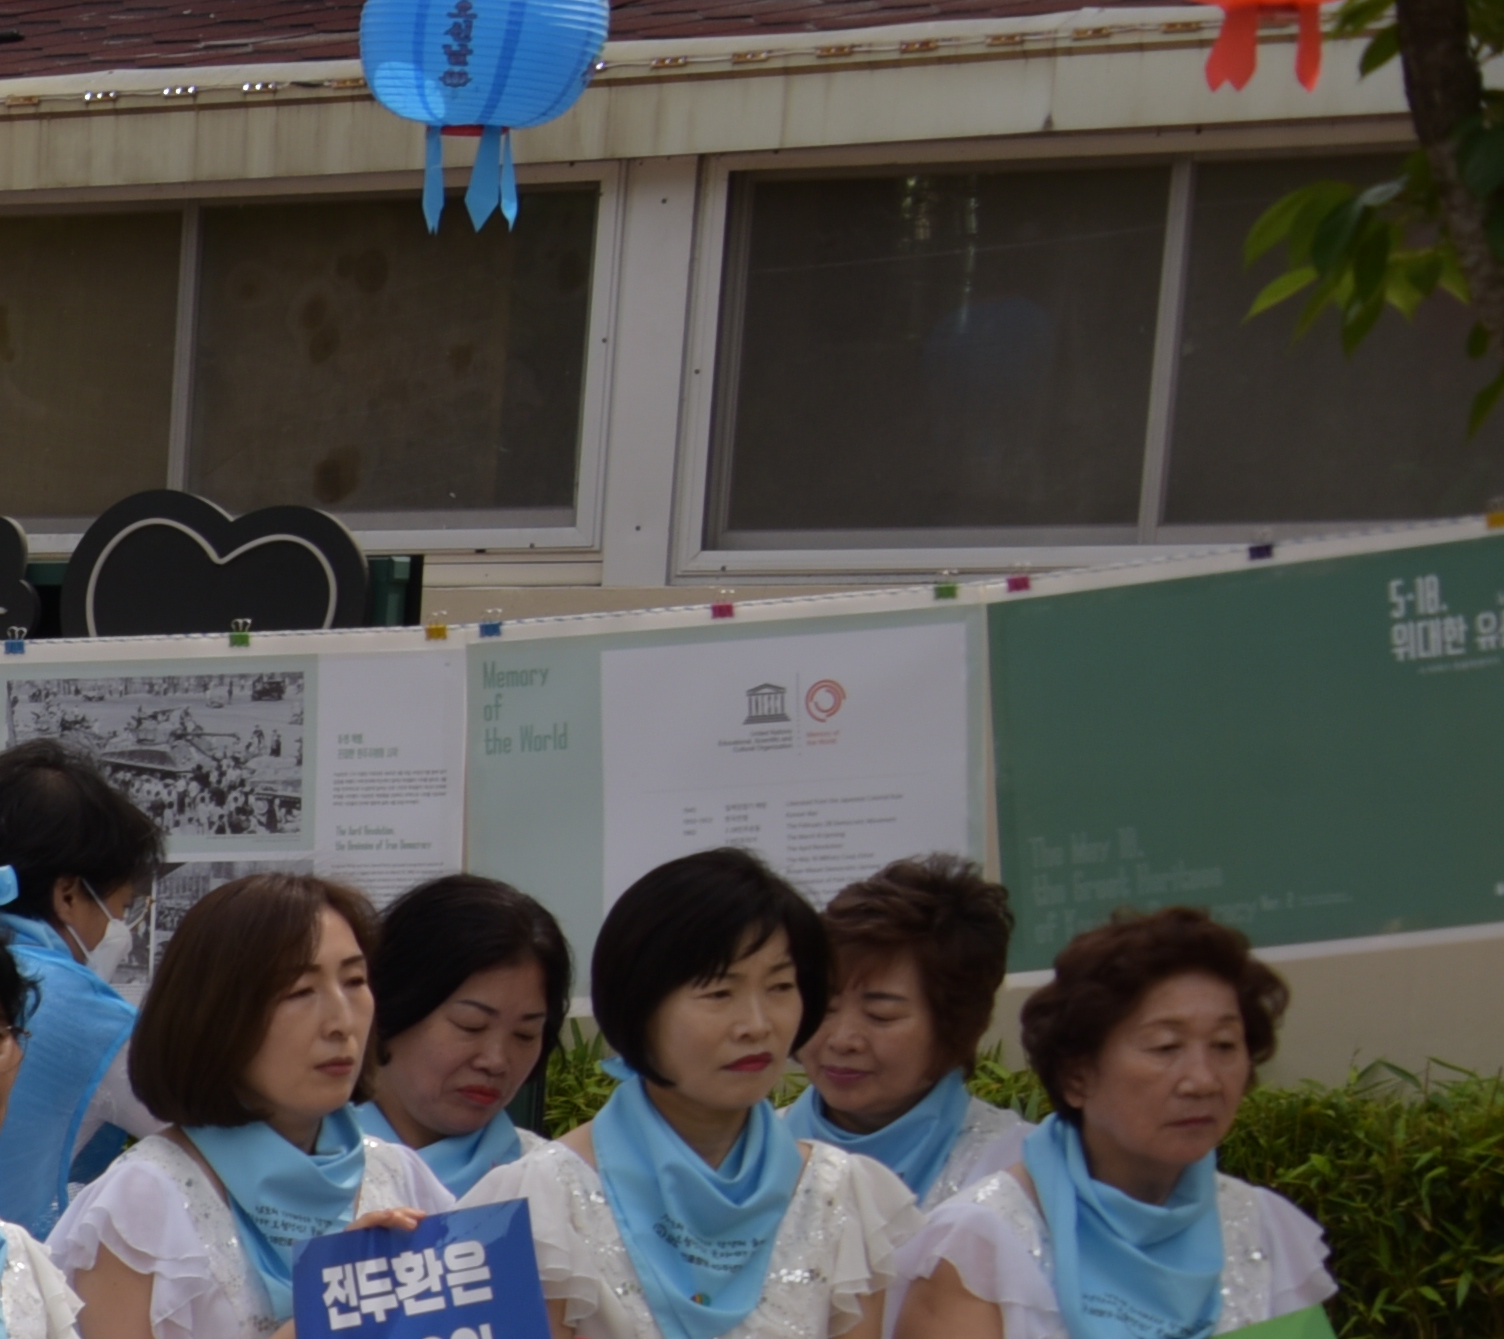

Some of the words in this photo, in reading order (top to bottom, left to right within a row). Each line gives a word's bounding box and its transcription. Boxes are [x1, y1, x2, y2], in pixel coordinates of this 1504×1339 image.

[482, 660, 551, 690] Memory
[482, 692, 504, 722] of
[483, 726, 513, 756] the
[519, 721, 569, 754] World
[321, 1241, 494, 1331] 전두환은
